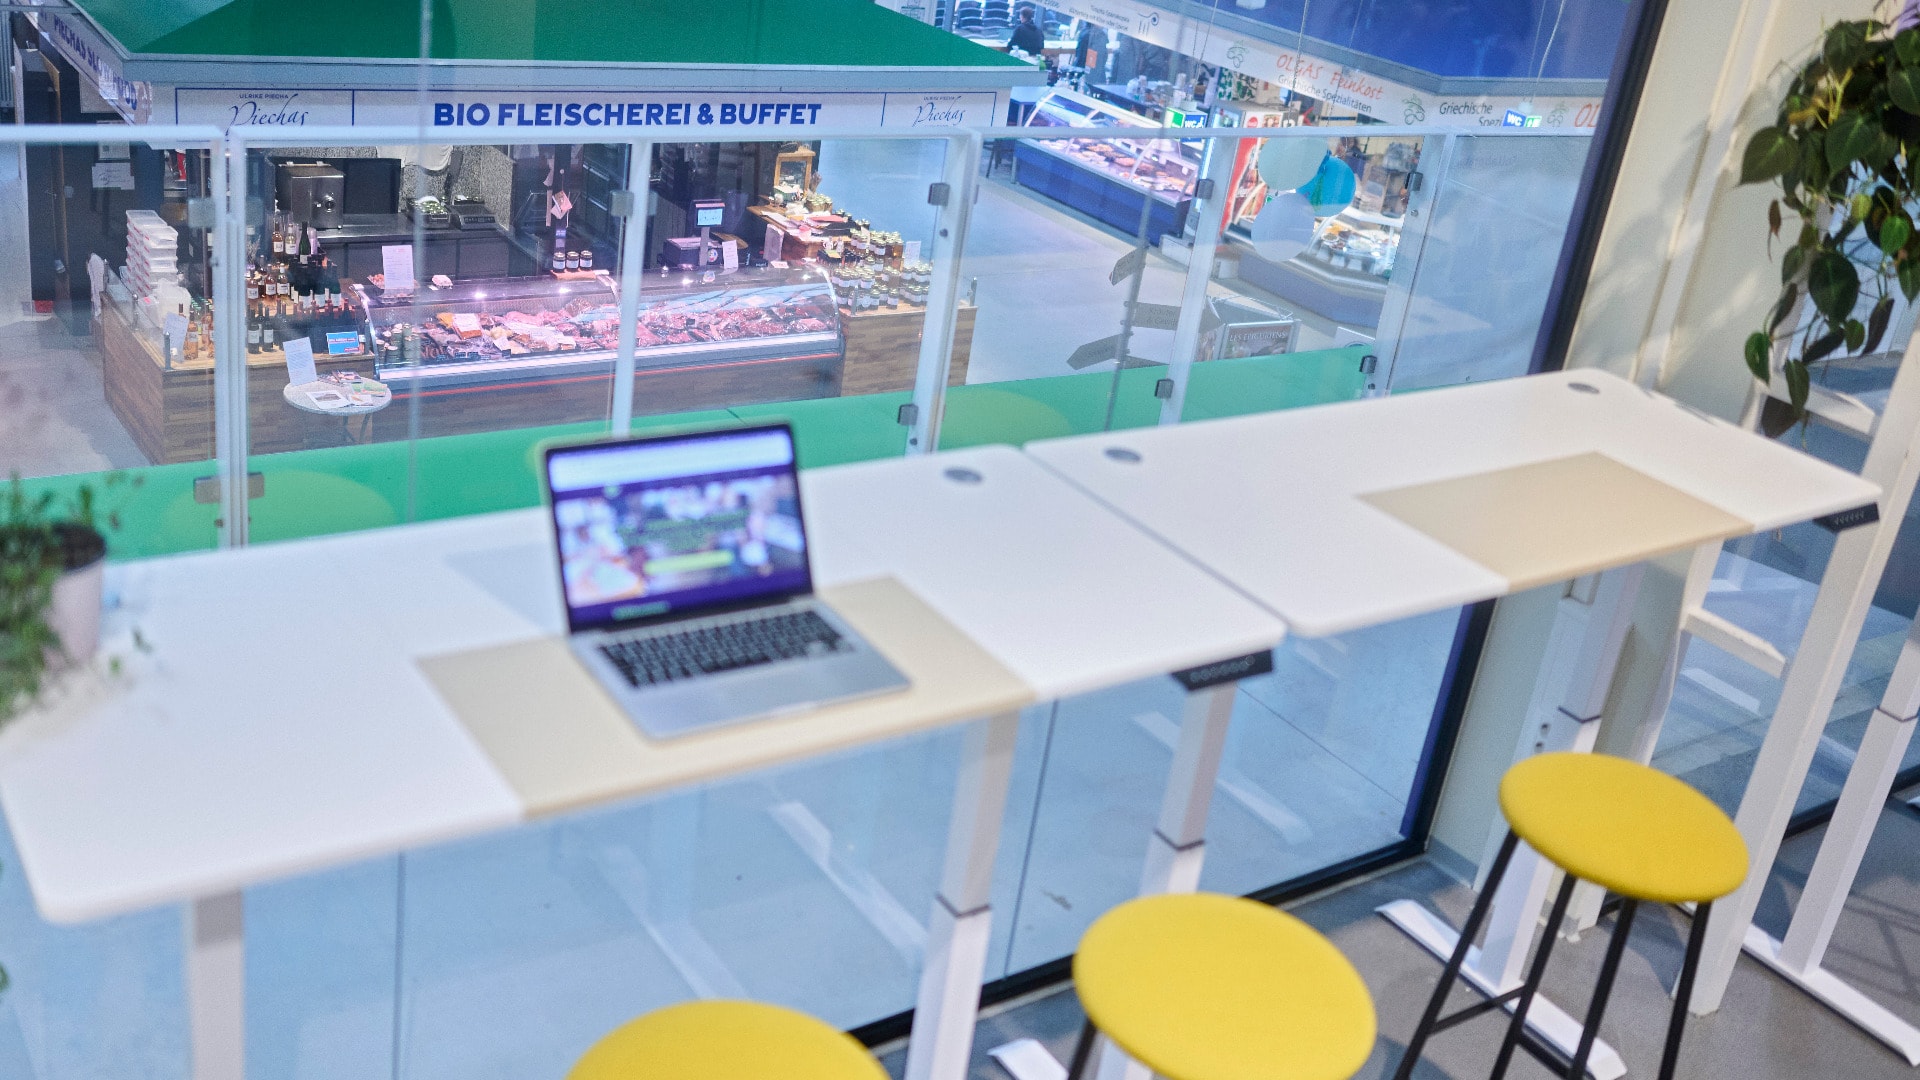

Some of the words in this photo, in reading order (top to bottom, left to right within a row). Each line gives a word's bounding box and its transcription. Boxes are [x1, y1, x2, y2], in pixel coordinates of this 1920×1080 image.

[1276, 54, 1323, 80] OLGAS
[1330, 71, 1384, 100] Feinkost
[1278, 74, 1321, 99] Griechische
[1322, 88, 1372, 114] Spezialitäten
[224, 93, 309, 136] Piechas
[433, 102, 491, 126] BIO
[497, 102, 691, 126] FLEISCHEREI
[696, 103, 714, 125] &
[719, 102, 822, 125] BUFFET
[911, 95, 966, 127] Piechas
[1439, 101, 1493, 116] Griechische
[1507, 113, 1522, 127] WC
[1184, 119, 1197, 128] WC
